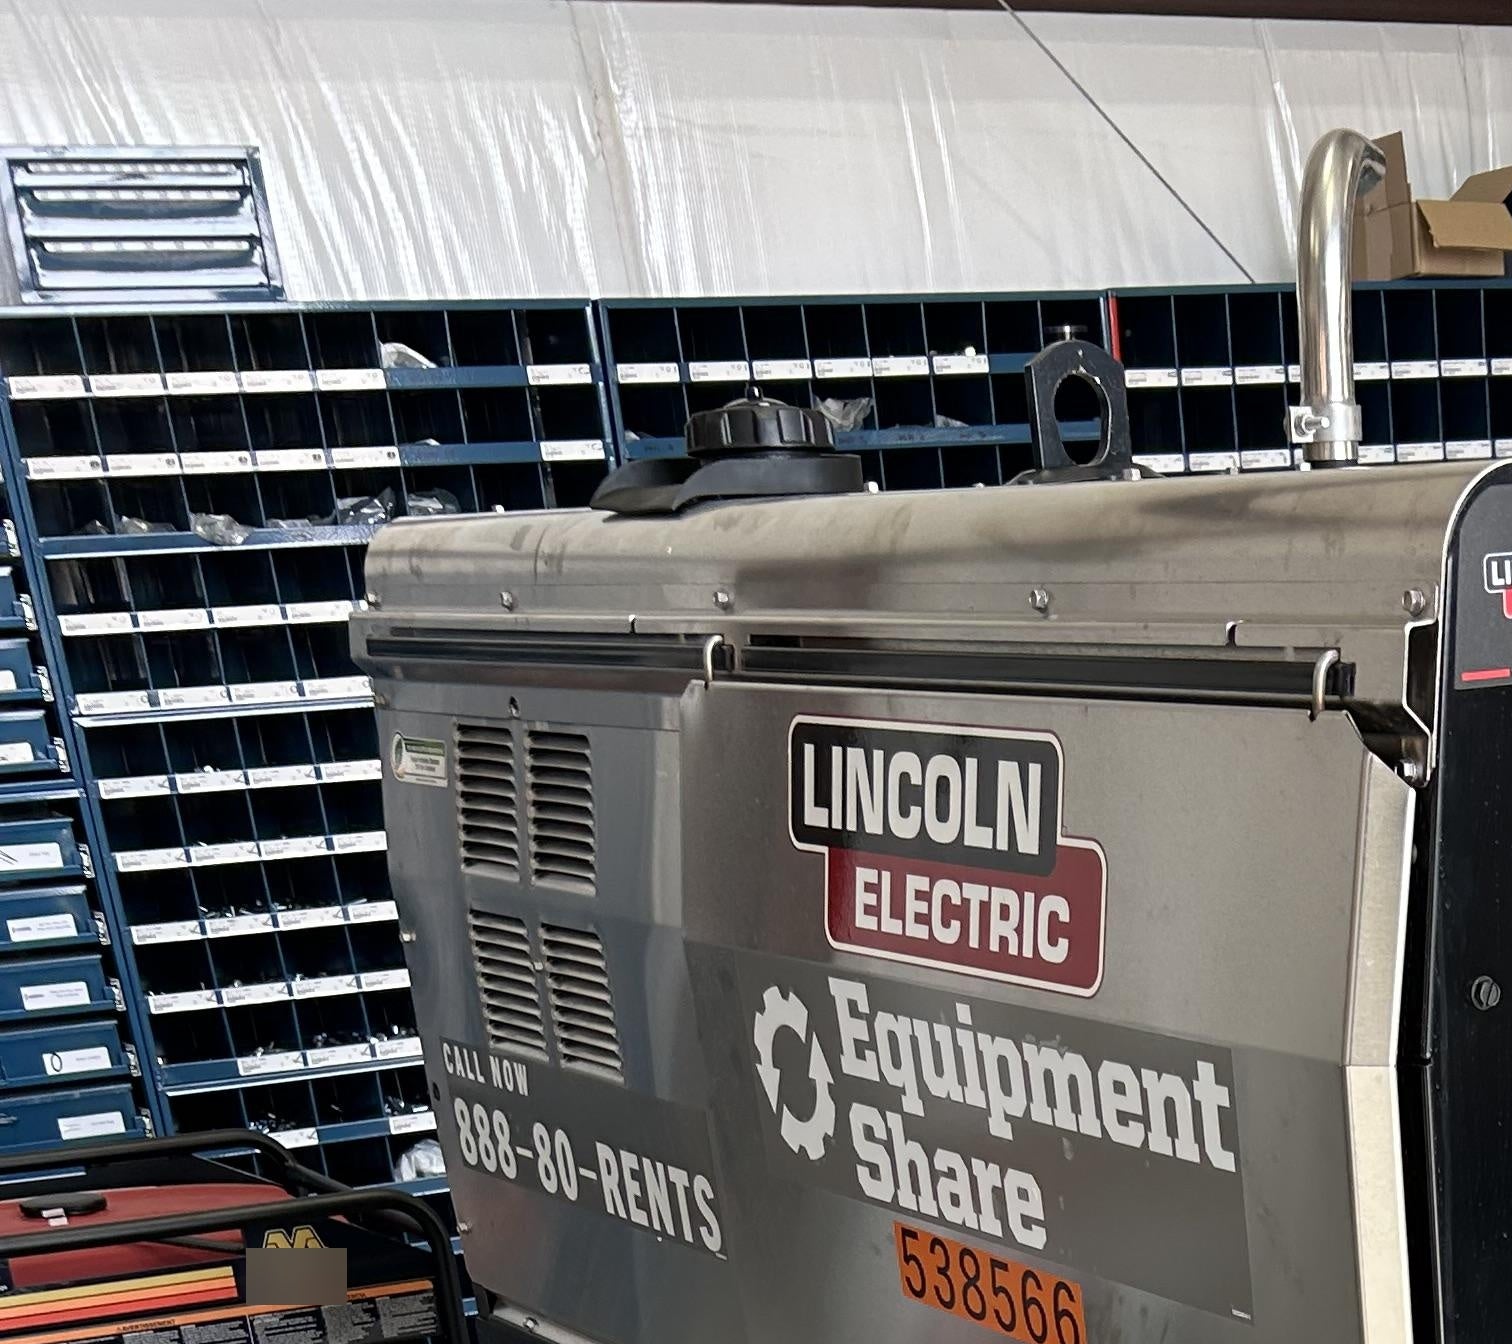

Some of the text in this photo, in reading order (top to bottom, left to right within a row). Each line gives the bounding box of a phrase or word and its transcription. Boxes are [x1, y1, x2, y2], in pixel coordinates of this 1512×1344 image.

[803, 743, 1042, 855] LINCOLN
[855, 867, 1071, 964] ELECTRIC
[442, 1043, 486, 1084] CALL
[489, 1055, 529, 1097] NOW
[828, 976, 1237, 1172] Equipment
[453, 1097, 722, 1252] 888-80-RENTS
[849, 1102, 1047, 1250] Share
